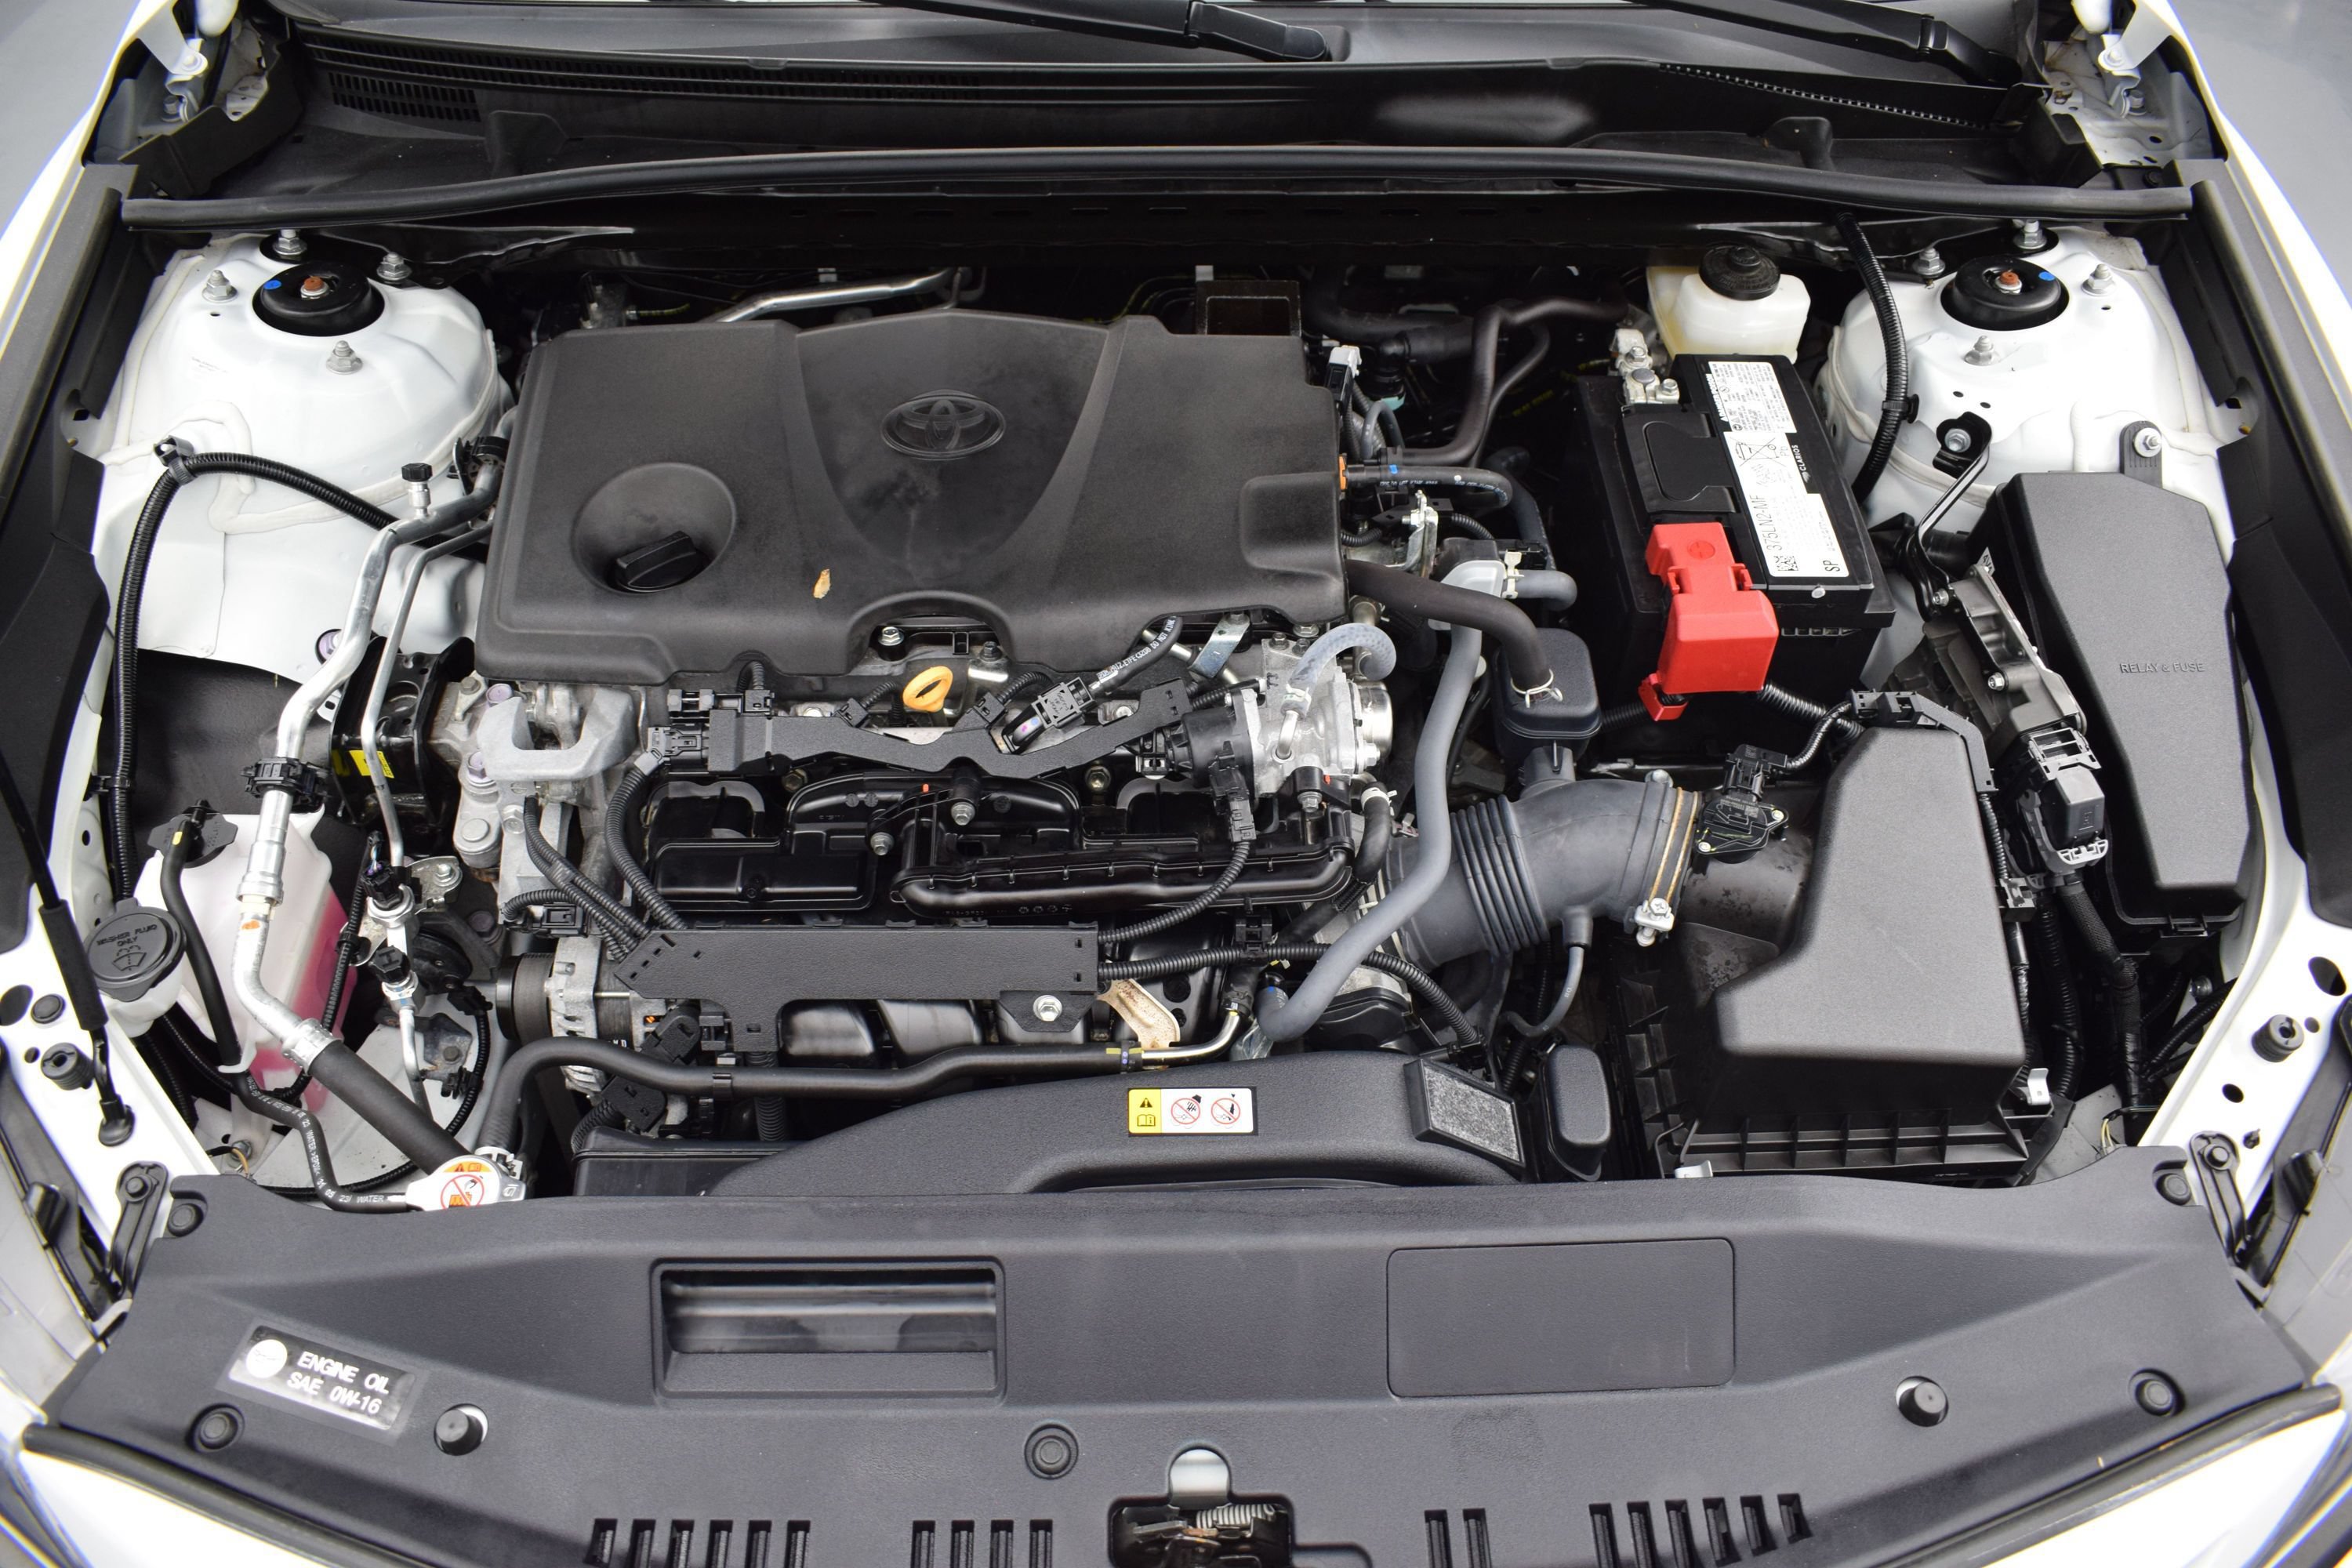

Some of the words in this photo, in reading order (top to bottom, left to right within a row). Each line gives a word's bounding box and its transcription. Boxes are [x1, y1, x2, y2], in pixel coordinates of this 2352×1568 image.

[1791, 445, 1807, 471] CLARIOS
[1749, 495, 1783, 551] 375LN2-MF
[1822, 560, 1841, 572] SP
[1150, 641, 1160, 649] DO
[1156, 632, 1168, 643] NOT
[1163, 619, 1176, 633] KINK
[2119, 662, 2158, 673] RELAY
[2161, 664, 2171, 673] &
[2172, 662, 2206, 673] FUSE
[96, 931, 130, 946] WASHER
[134, 924, 158, 935] FLUID
[117, 936, 138, 947] ONLY
[306, 1129, 318, 1152] WATER
[357, 1195, 385, 1203] WATER
[297, 1350, 360, 1384] ENGINE
[364, 1373, 390, 1395] OIL
[287, 1371, 325, 1396] SAE
[329, 1385, 383, 1414] 0W-16
